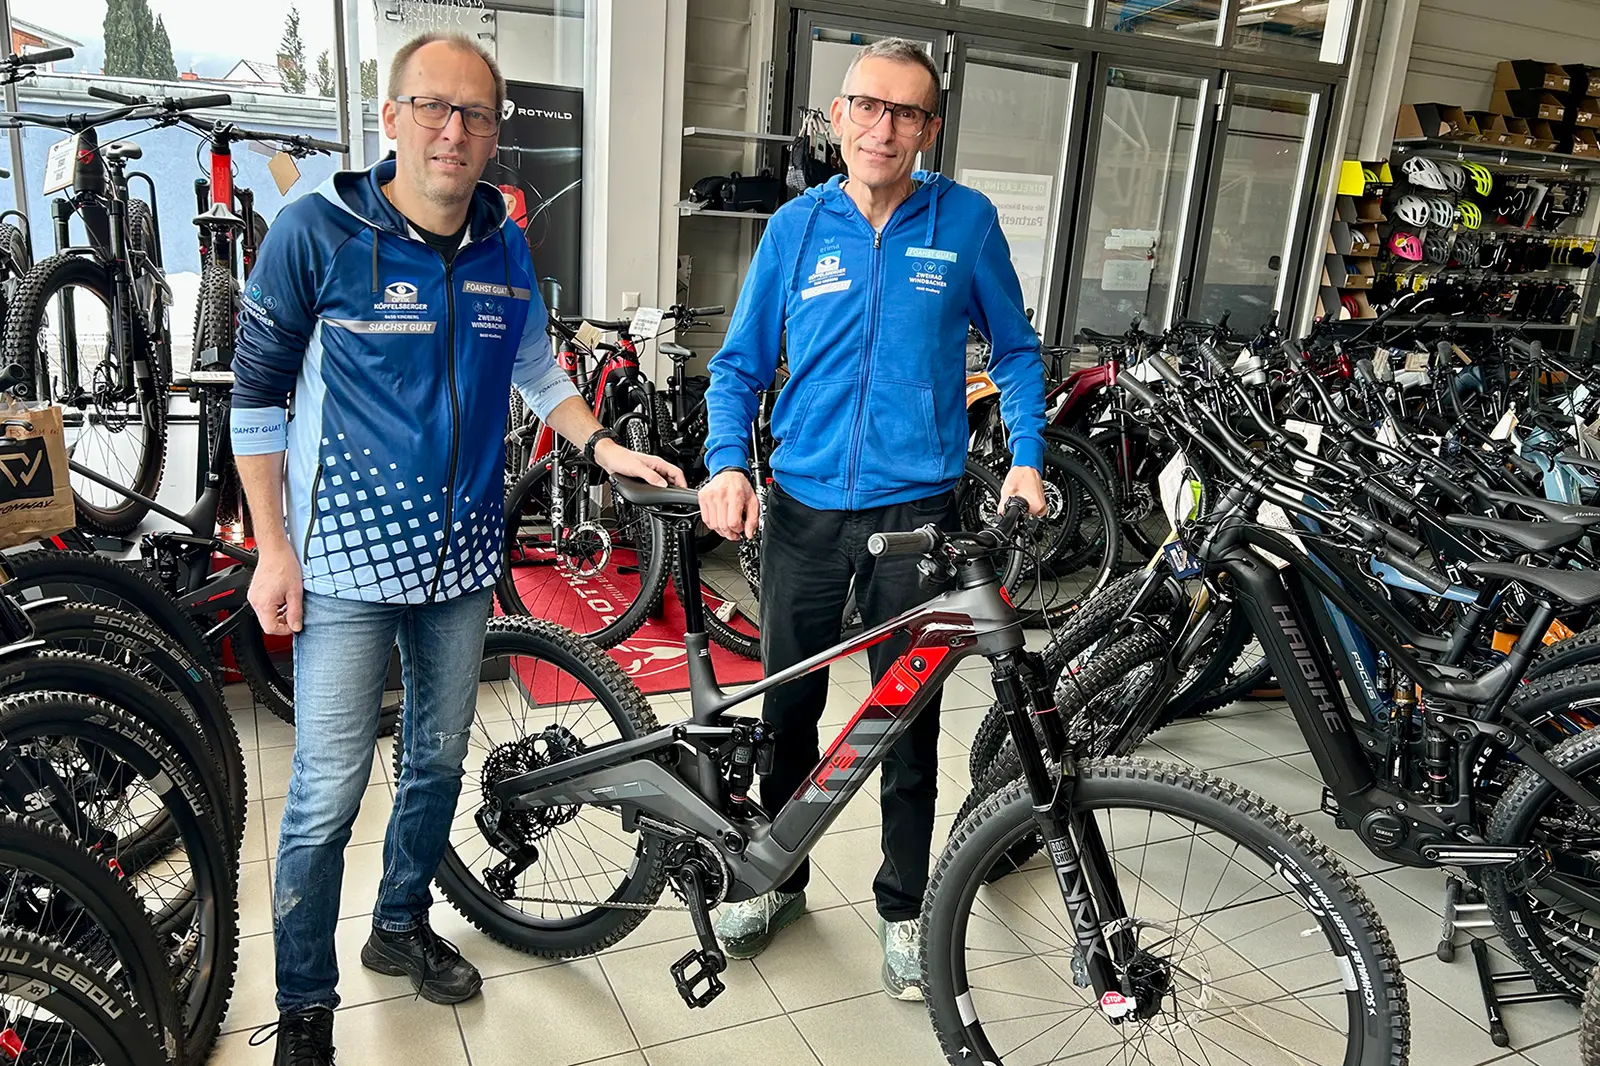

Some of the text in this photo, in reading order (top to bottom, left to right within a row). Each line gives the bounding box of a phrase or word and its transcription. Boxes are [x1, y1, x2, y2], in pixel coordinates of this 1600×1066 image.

[517, 107, 573, 120] ROTWILD
[908, 276, 947, 288] WINDBACHER
[915, 271, 943, 281] ZWEIRAD
[465, 282, 508, 295] FOAHST GUAT
[373, 302, 428, 310] KÖPFELSBERGER
[477, 314, 503, 323] ZWEIRAD
[368, 323, 433, 332] SIACHST GUAT
[470, 321, 507, 331] WINDBACHER
[261, 423, 281, 433] GUAT
[550, 497, 564, 529] FOX
[93, 614, 192, 671] SCHWALBE
[1271, 604, 1346, 734] HAIBIKE
[1350, 651, 1377, 701] FOCUS
[108, 721, 204, 818] MAGIC MARY
[1375, 828, 1394, 837] YAMAHA
[1050, 838, 1070, 852] ROCK
[1309, 880, 1335, 911] TRAIL
[1056, 864, 1108, 966] LYRIK
[1328, 910, 1359, 950] ALBERT
[1509, 909, 1586, 995] HWALBE
[1350, 949, 1377, 1007] SCHWALBE
[32, 956, 124, 1020] NOBBY
[1105, 996, 1122, 1004] STOP
